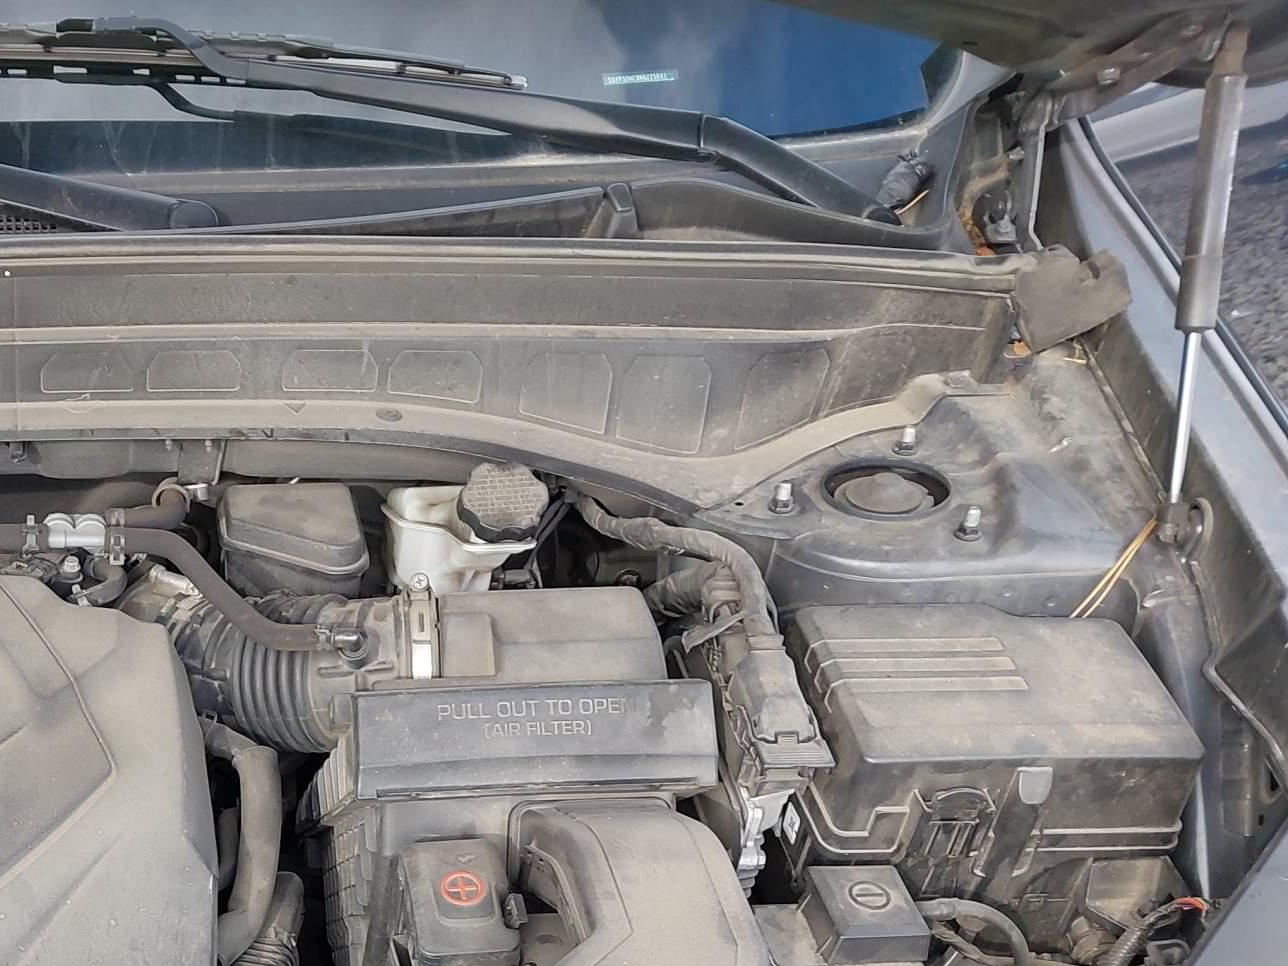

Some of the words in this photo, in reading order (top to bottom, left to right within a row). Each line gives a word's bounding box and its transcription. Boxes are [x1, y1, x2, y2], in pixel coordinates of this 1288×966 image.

[436, 703, 492, 721] PULL
[496, 700, 540, 718] OUT
[544, 699, 573, 716] TO
